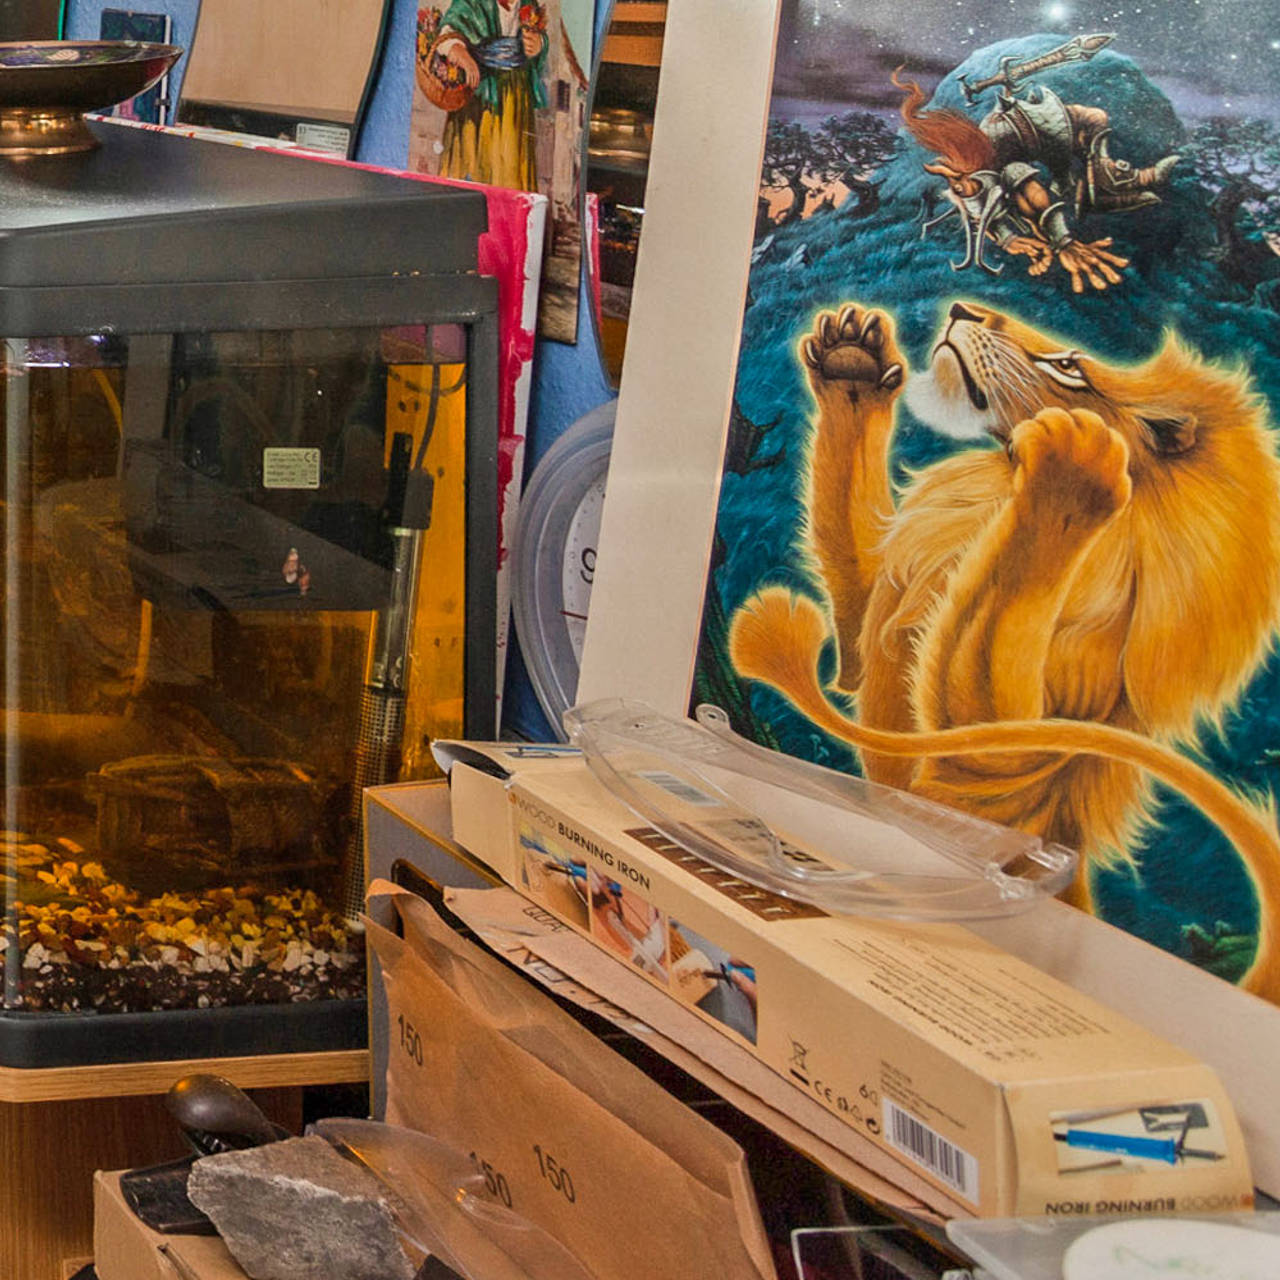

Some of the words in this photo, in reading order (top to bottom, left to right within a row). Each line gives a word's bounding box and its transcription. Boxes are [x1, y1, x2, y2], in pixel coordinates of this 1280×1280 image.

[581, 547, 597, 585] 9
[516, 798, 557, 829] WOOD
[557, 821, 615, 867] BURNING
[617, 859, 651, 891] IRON
[397, 1013, 424, 1067] 150
[533, 1144, 576, 1204] 150
[1045, 1201, 1091, 1216] IRON
[1095, 1197, 1176, 1214] BURNING
